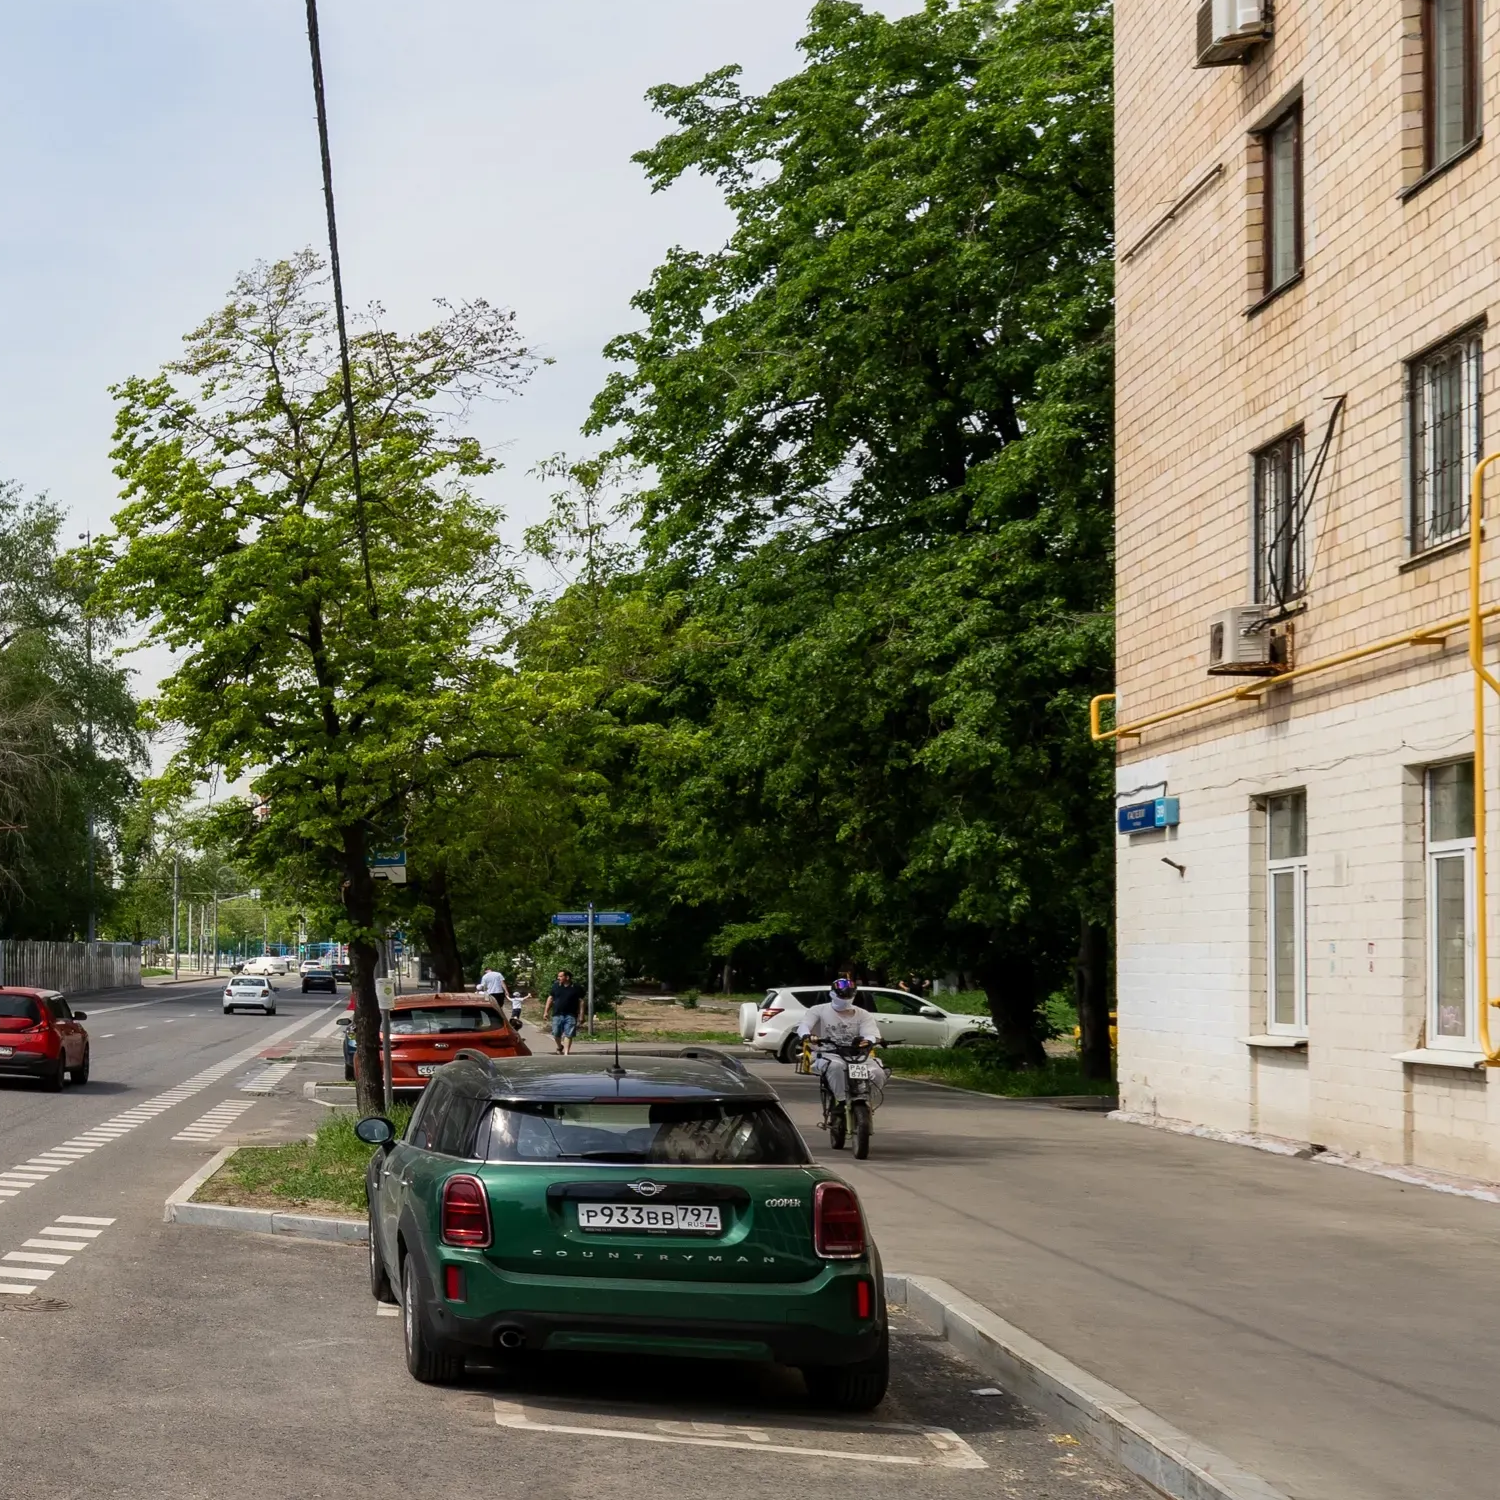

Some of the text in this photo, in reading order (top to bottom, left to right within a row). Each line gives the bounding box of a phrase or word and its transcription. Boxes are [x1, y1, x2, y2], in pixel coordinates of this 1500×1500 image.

[765, 1199, 801, 1208] COOPER
[679, 1207, 713, 1222] 797
[532, 1249, 776, 1264] COUNTRYMAN
